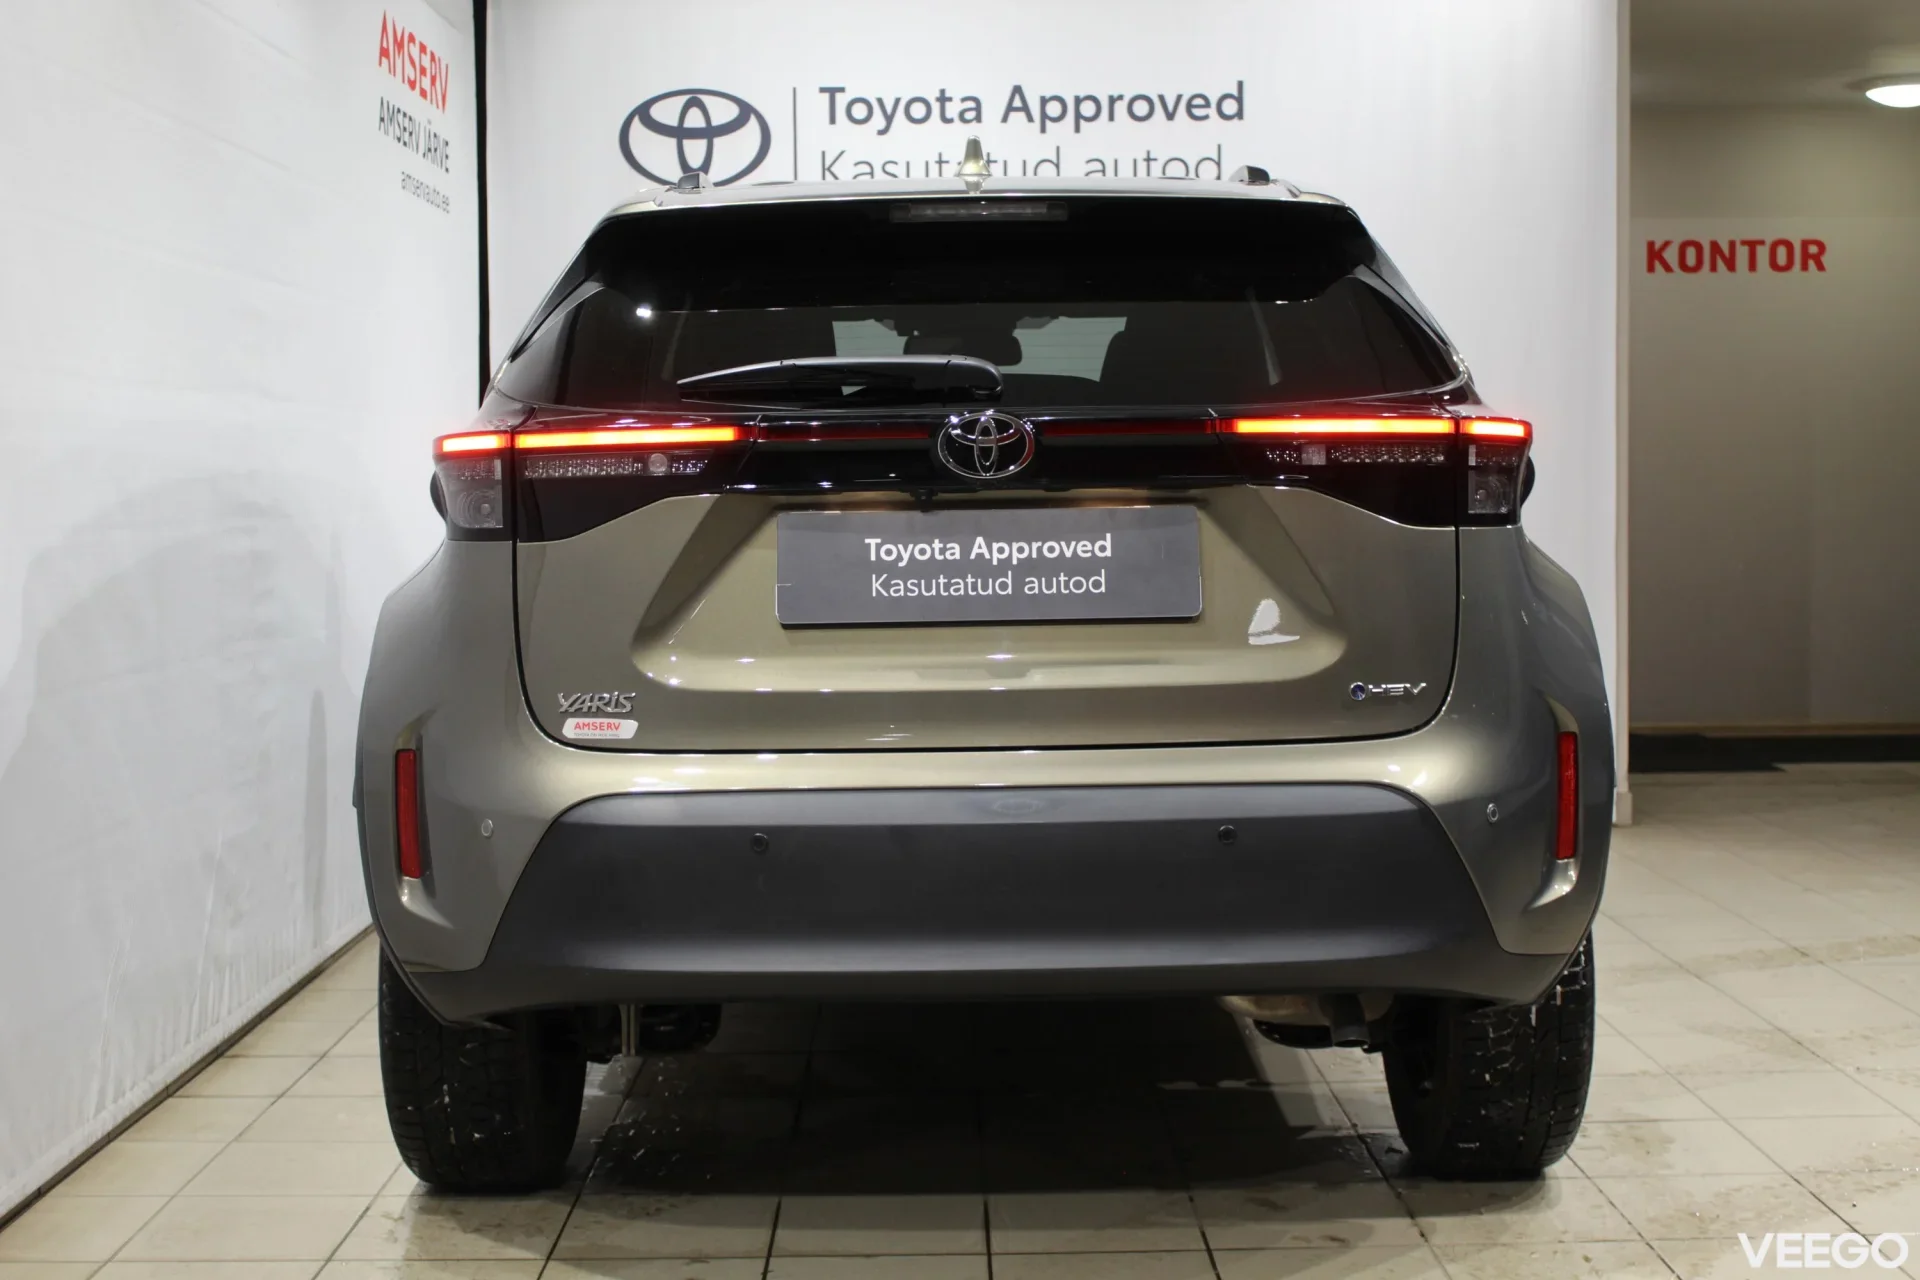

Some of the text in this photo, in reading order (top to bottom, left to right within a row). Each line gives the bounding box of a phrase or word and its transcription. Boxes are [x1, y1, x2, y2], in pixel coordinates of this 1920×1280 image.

[379, 10, 449, 114] AMSERV
[819, 80, 1245, 135] Toyota Approved
[379, 96, 449, 173] AMSERV JÄRVE
[820, 144, 1222, 180] Kasuttud autod
[1646, 238, 1827, 273] KONTOR
[865, 534, 1112, 565] Toyota Approved
[872, 570, 1106, 596] Kasutatud autod
[1368, 682, 1427, 696] HEV
[574, 722, 621, 731] AMSERV
